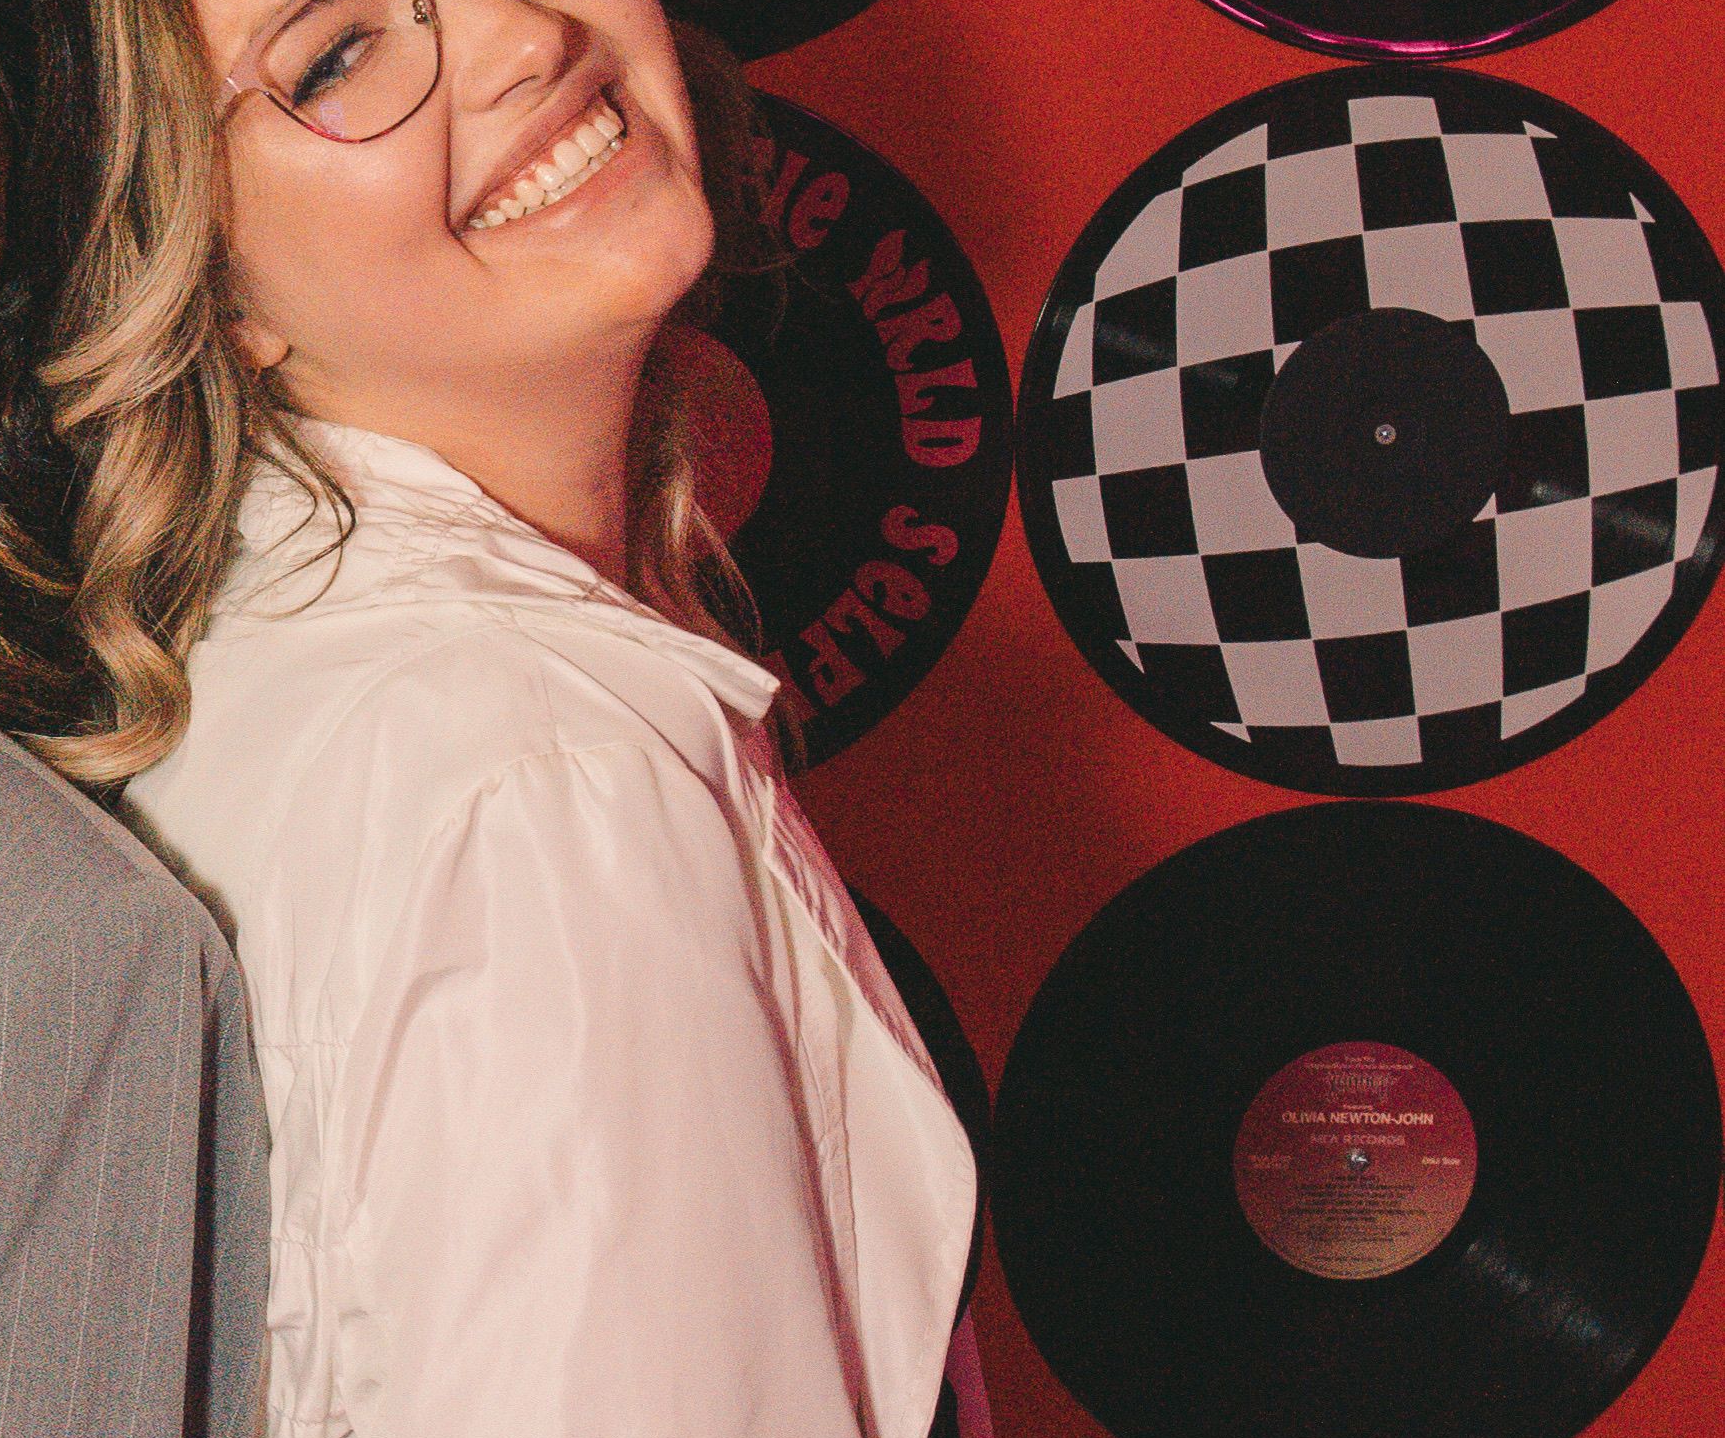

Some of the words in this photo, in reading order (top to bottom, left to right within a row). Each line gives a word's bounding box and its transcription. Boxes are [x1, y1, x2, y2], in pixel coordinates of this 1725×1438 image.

[847, 227, 984, 469] WRLD
[1281, 1110, 1326, 1124] OLIVIA
[1329, 1111, 1434, 1126] NEWTON-JOHN
